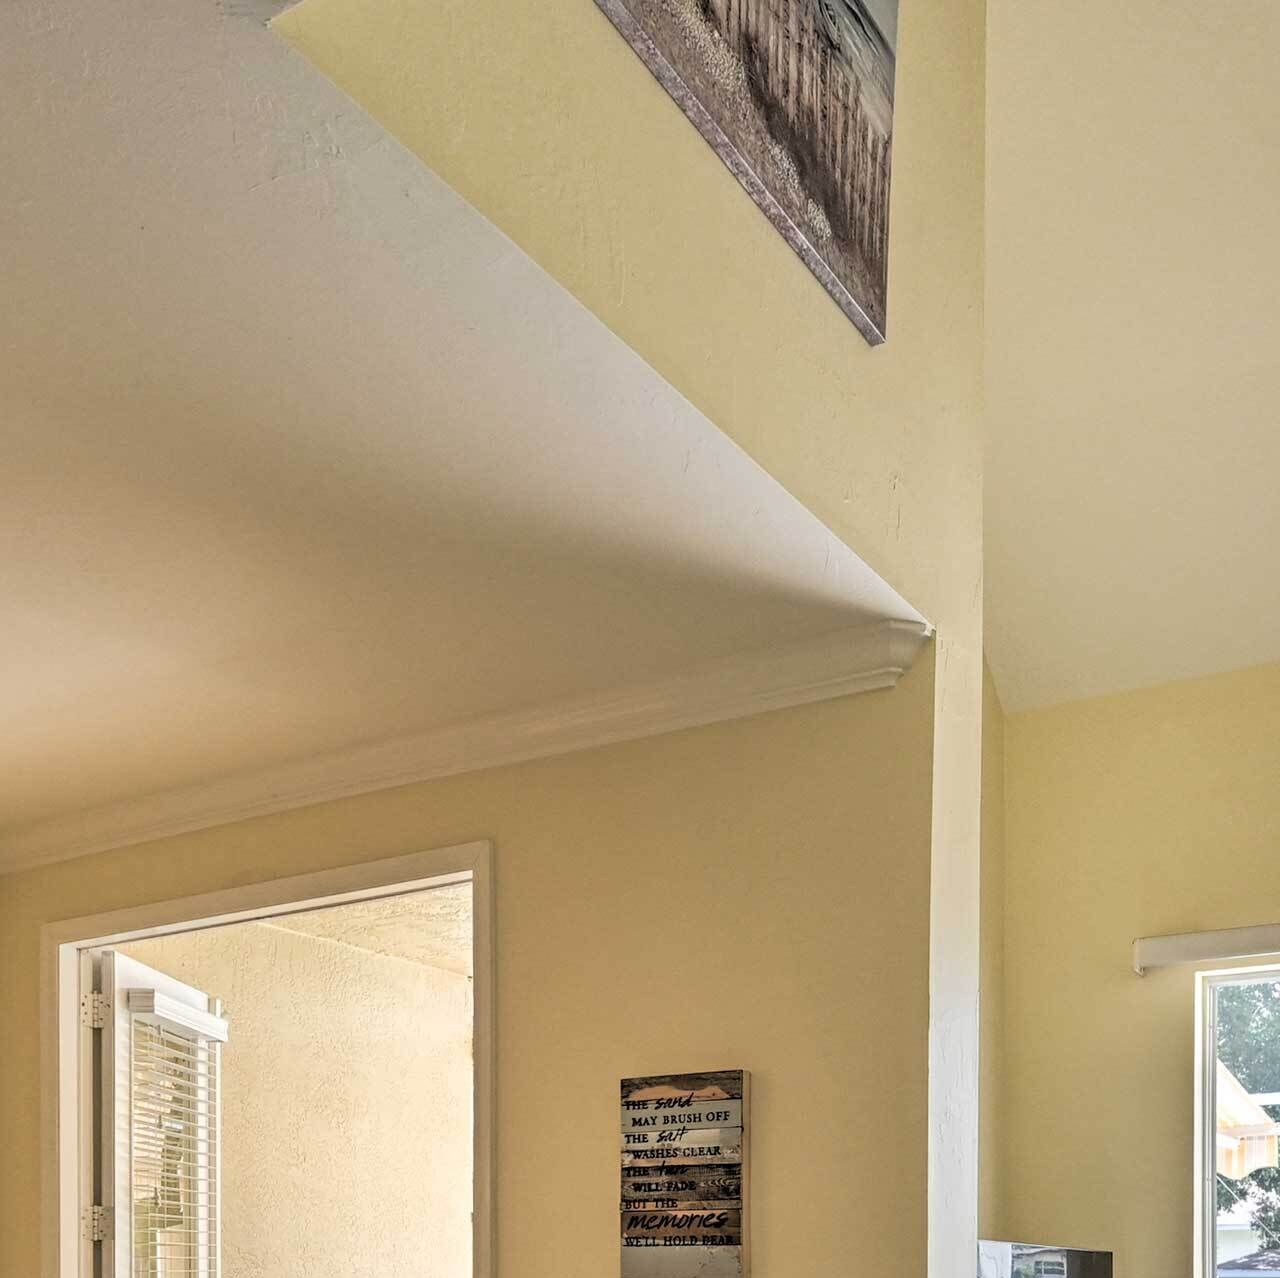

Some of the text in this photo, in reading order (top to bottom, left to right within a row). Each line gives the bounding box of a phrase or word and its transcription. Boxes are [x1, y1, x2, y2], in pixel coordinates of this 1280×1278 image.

[623, 1101, 649, 1110] THE
[632, 1111, 731, 1127] MAY BRUSH OFF
[624, 1126, 688, 1144] THE salt
[632, 1146, 722, 1160] WASHES CLEAR
[624, 1167, 650, 1177] THE
[666, 1181, 697, 1191] FADE
[625, 1199, 679, 1209] BUT THE
[627, 1212, 729, 1230] memories
[663, 1235, 697, 1245] HOLD
